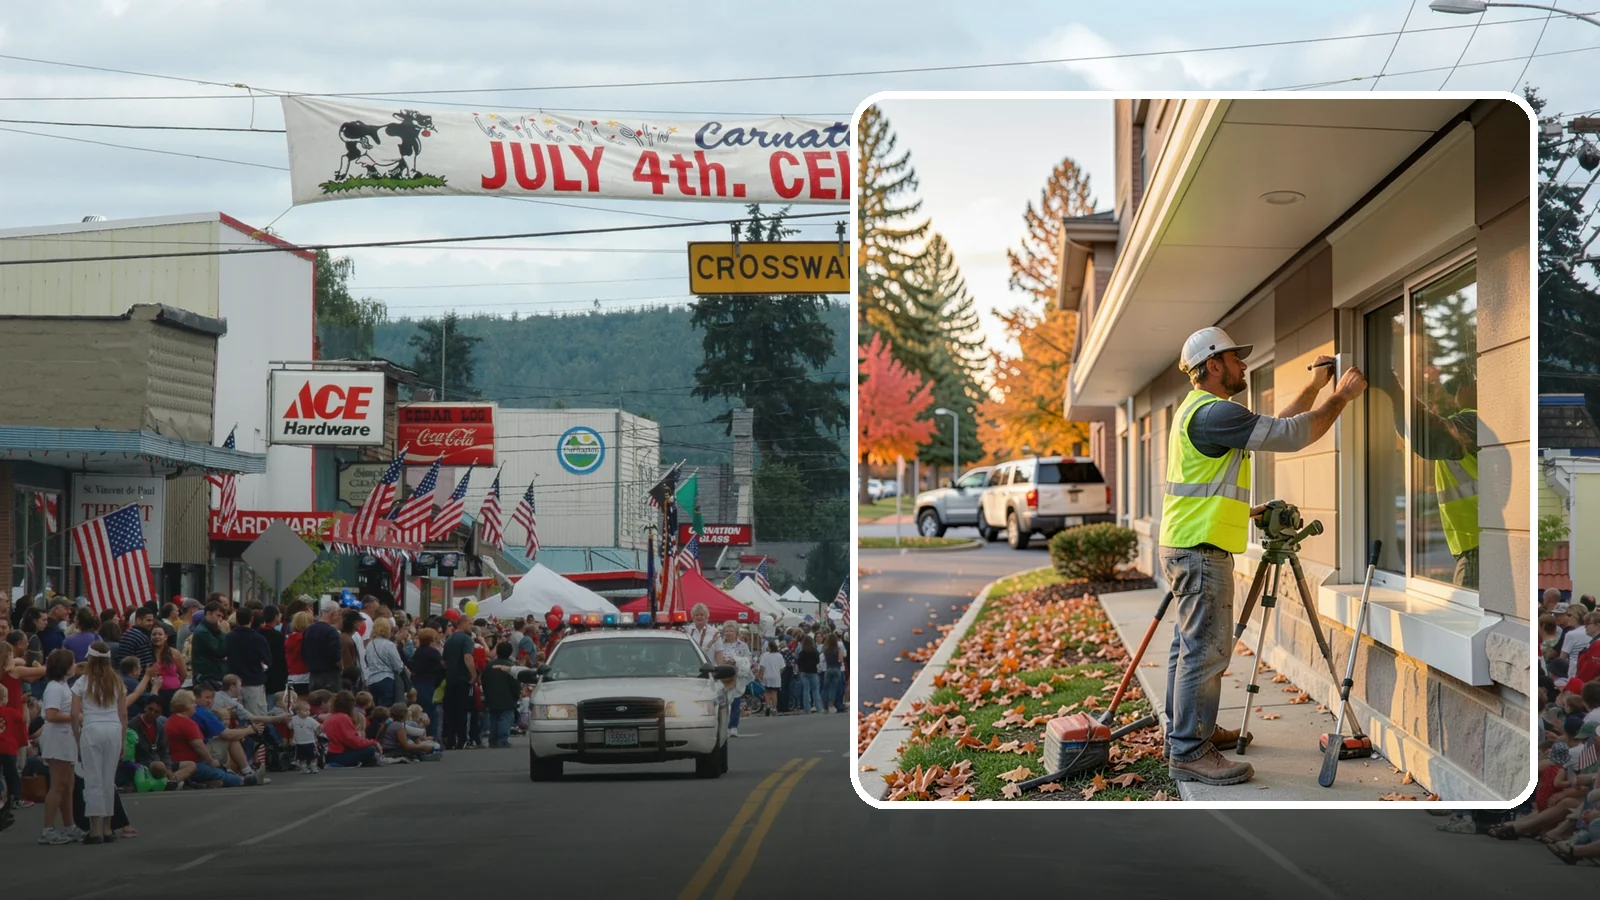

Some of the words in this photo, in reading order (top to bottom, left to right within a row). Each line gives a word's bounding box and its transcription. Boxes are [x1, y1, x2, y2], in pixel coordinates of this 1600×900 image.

[694, 121, 850, 150] Carnat
[481, 141, 604, 193] JULY
[633, 150, 746, 198] 4th.
[697, 254, 850, 280] CROSSWA
[283, 380, 373, 420] ACE
[406, 410, 452, 422] CEDAR
[461, 409, 484, 422] LOG
[283, 421, 371, 436] Hardware
[353, 467, 384, 481] Simpl
[83, 484, 93, 495] St.
[96, 485, 124, 495] Vincent
[126, 485, 136, 495] de
[138, 485, 155, 496] Paul
[688, 526, 741, 535] CRNATION
[699, 535, 730, 543] GLASS
